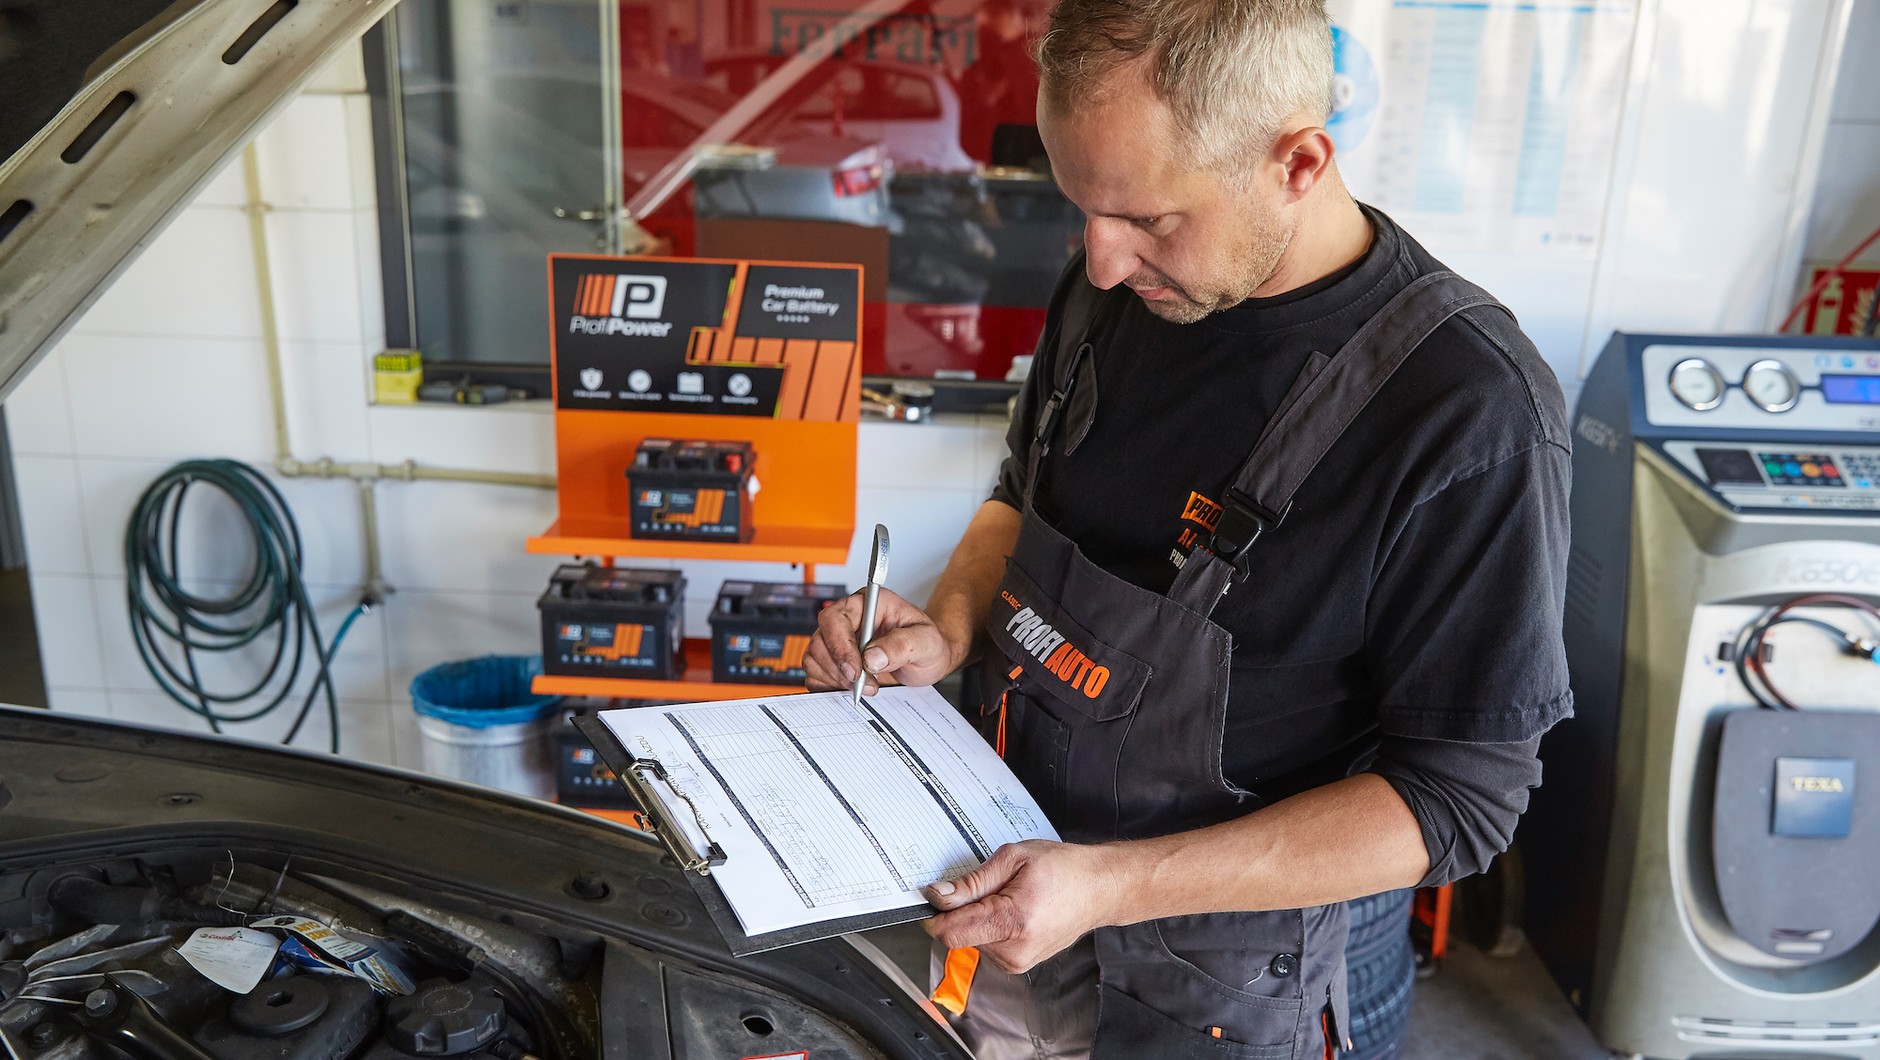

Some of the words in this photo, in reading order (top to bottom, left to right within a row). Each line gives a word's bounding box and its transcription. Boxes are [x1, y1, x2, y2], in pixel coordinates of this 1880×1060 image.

[769, 9, 979, 66] Ferrari
[764, 284, 825, 300] Premium
[761, 299, 789, 313] Car
[791, 300, 840, 316] Battery
[569, 315, 673, 338] ProfiPower
[1005, 606, 1110, 699] PROFIAUTO
[1791, 776, 1843, 793] TEXA
